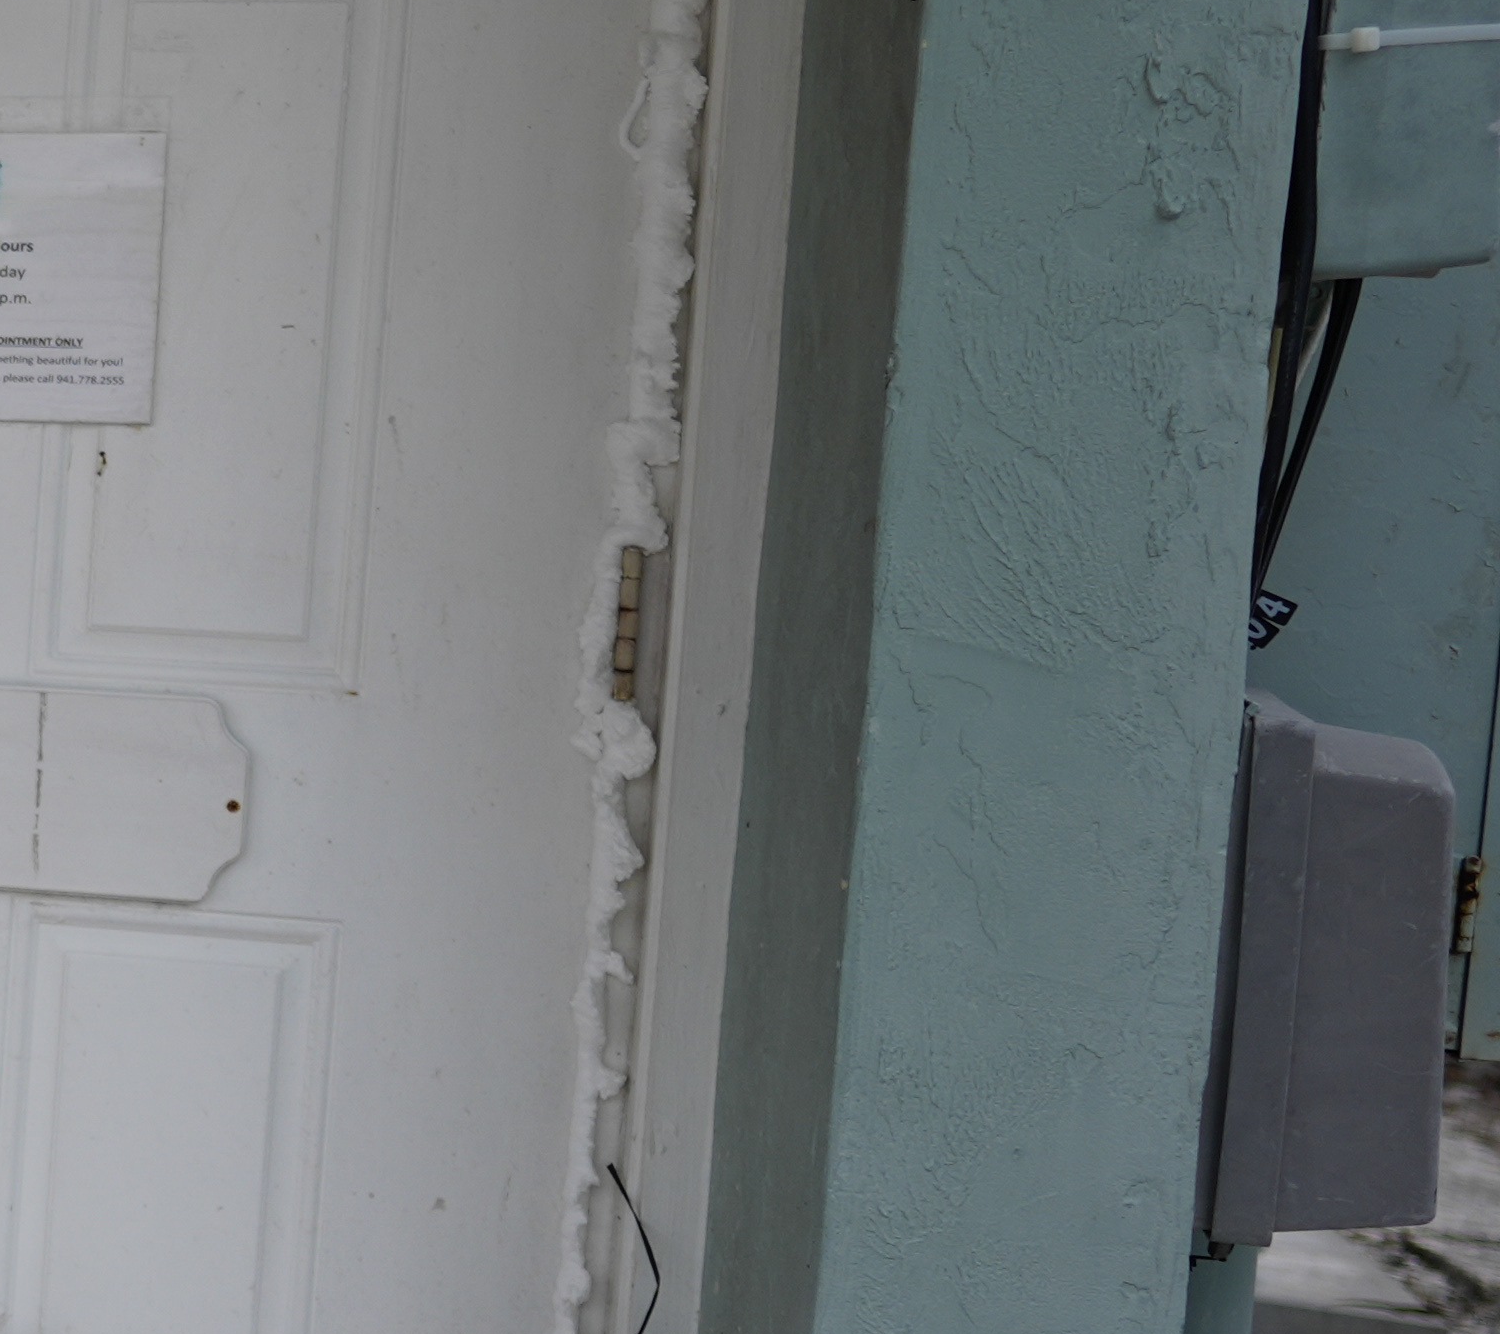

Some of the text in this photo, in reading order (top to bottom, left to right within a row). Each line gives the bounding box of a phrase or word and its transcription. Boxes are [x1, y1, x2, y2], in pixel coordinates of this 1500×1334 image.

[0, 293, 32, 306] p.m.
[55, 337, 84, 348] ONLY
[37, 356, 81, 365] beautiful
[84, 357, 98, 366] for
[101, 357, 124, 367] you!
[3, 374, 35, 383] please
[37, 375, 54, 383] call
[56, 375, 125, 385] 941.778.2555
[1248, 596, 1290, 646] 04
